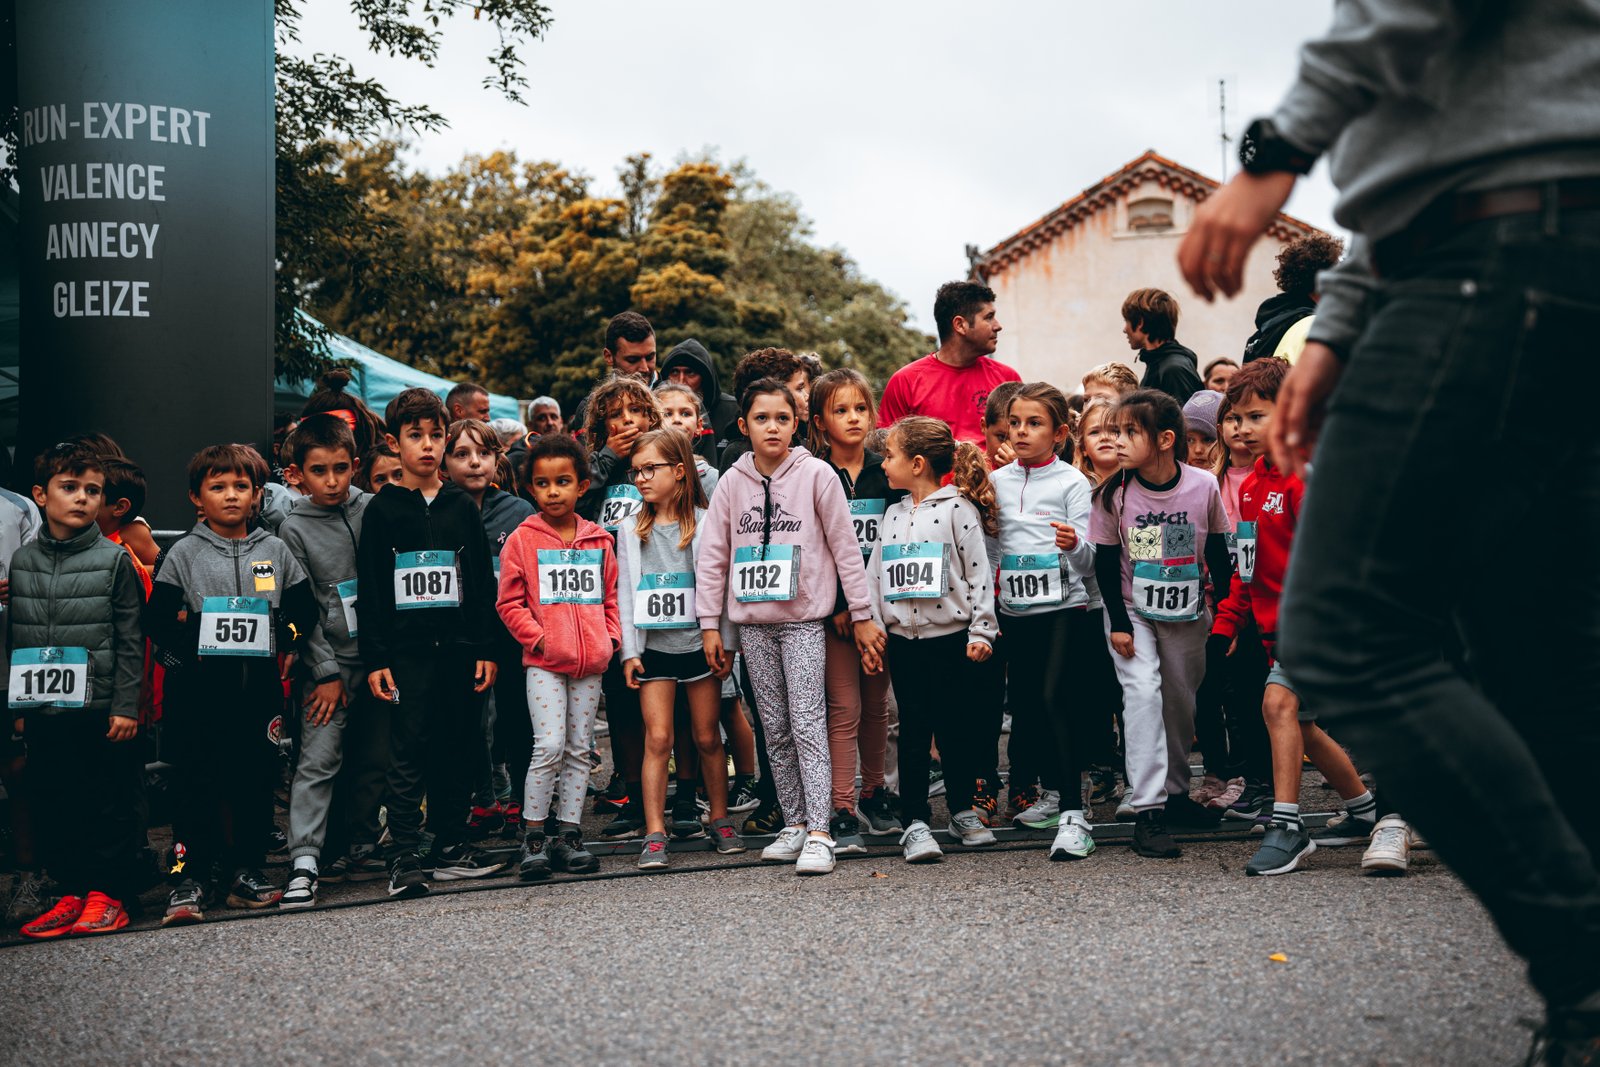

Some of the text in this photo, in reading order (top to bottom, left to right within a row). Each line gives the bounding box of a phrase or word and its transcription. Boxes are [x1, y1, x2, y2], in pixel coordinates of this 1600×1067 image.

[24, 102, 211, 147] RUN-EXPERT
[41, 163, 166, 202] VALENCE
[46, 222, 160, 260] ANNECY
[53, 280, 150, 318] GLEIZE
[603, 501, 632, 523] 521
[736, 512, 802, 535] Barelona
[852, 518, 878, 543] 26
[401, 571, 451, 596] 1087
[547, 568, 595, 593] 1136
[739, 564, 781, 590] 1132
[886, 562, 934, 588] 1094
[1006, 573, 1049, 598] 1101
[647, 592, 686, 618] 681
[1143, 584, 1190, 610] 1131
[215, 617, 258, 643] 557
[20, 668, 75, 695] 1120
